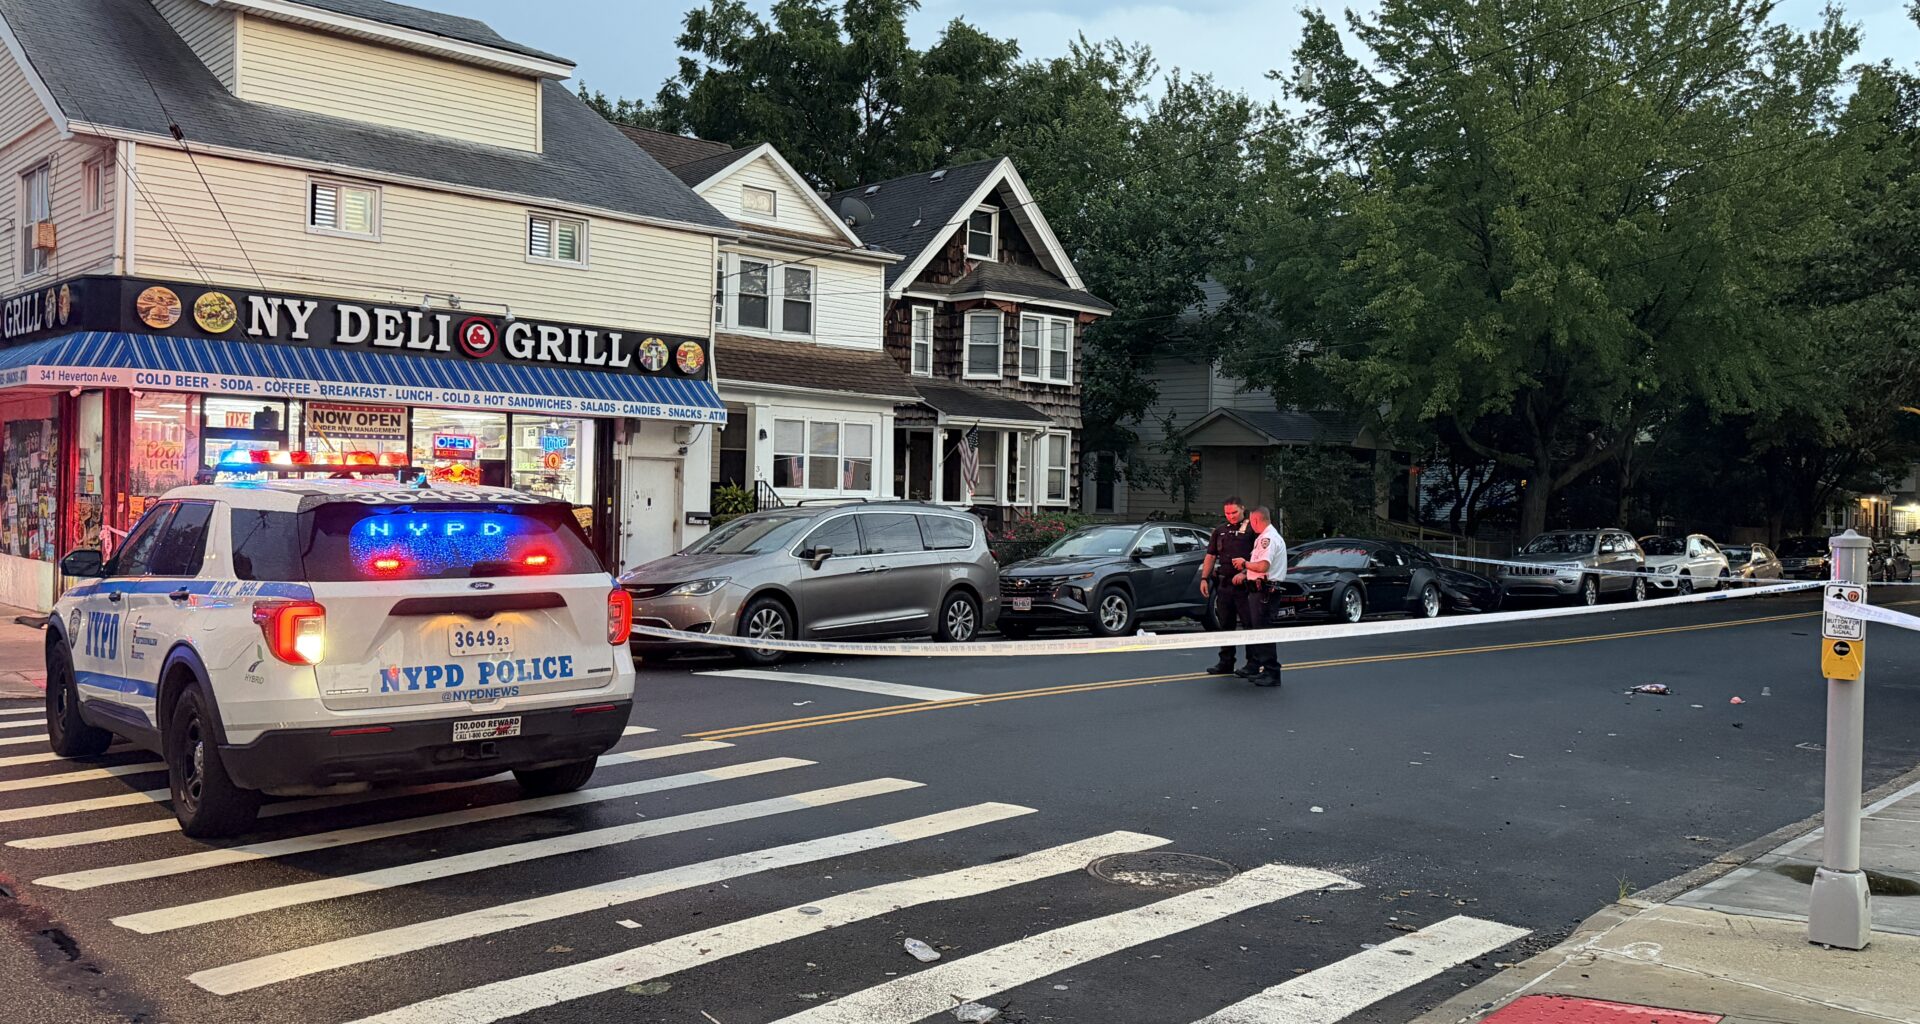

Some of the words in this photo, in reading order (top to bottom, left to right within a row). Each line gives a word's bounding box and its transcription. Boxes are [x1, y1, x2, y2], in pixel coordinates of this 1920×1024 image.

[4, 292, 42, 338] GRILL
[248, 295, 318, 340] NY
[336, 304, 450, 352] DELI
[469, 325, 487, 345] &
[505, 322, 631, 368] GRILL
[40, 370, 55, 381] 341
[58, 370, 98, 382] Heverton
[100, 371, 119, 383] Ave.
[136, 372, 171, 386] COLD
[175, 375, 209, 388] BEER
[220, 378, 253, 391] SODA
[264, 381, 310, 394] COFFEE
[320, 384, 386, 398] BREAKFAST
[395, 389, 433, 401] LUNCH
[442, 392, 470, 404] COLD
[473, 394, 480, 404] &
[484, 395, 505, 406] HOT
[508, 396, 572, 410] SANDWICHES
[580, 401, 616, 413] SALADS
[623, 404, 661, 416] CANDIES
[668, 407, 702, 419] SNACKS
[709, 411, 726, 421] ATM
[313, 410, 352, 425] NOW
[356, 413, 401, 427] OPEN
[437, 437, 471, 448] OPEN
[149, 460, 186, 470] LIGHT
[86, 611, 120, 660] NYPD
[455, 630, 495, 648] 3649
[497, 636, 509, 646] 23
[244, 673, 264, 685] HYBRID
[379, 663, 464, 693] NYPD
[478, 655, 574, 685] POLICE
[441, 686, 519, 702] @NYPDNEWS
[455, 721, 486, 731] $10,000
[488, 718, 519, 727] REWARD
